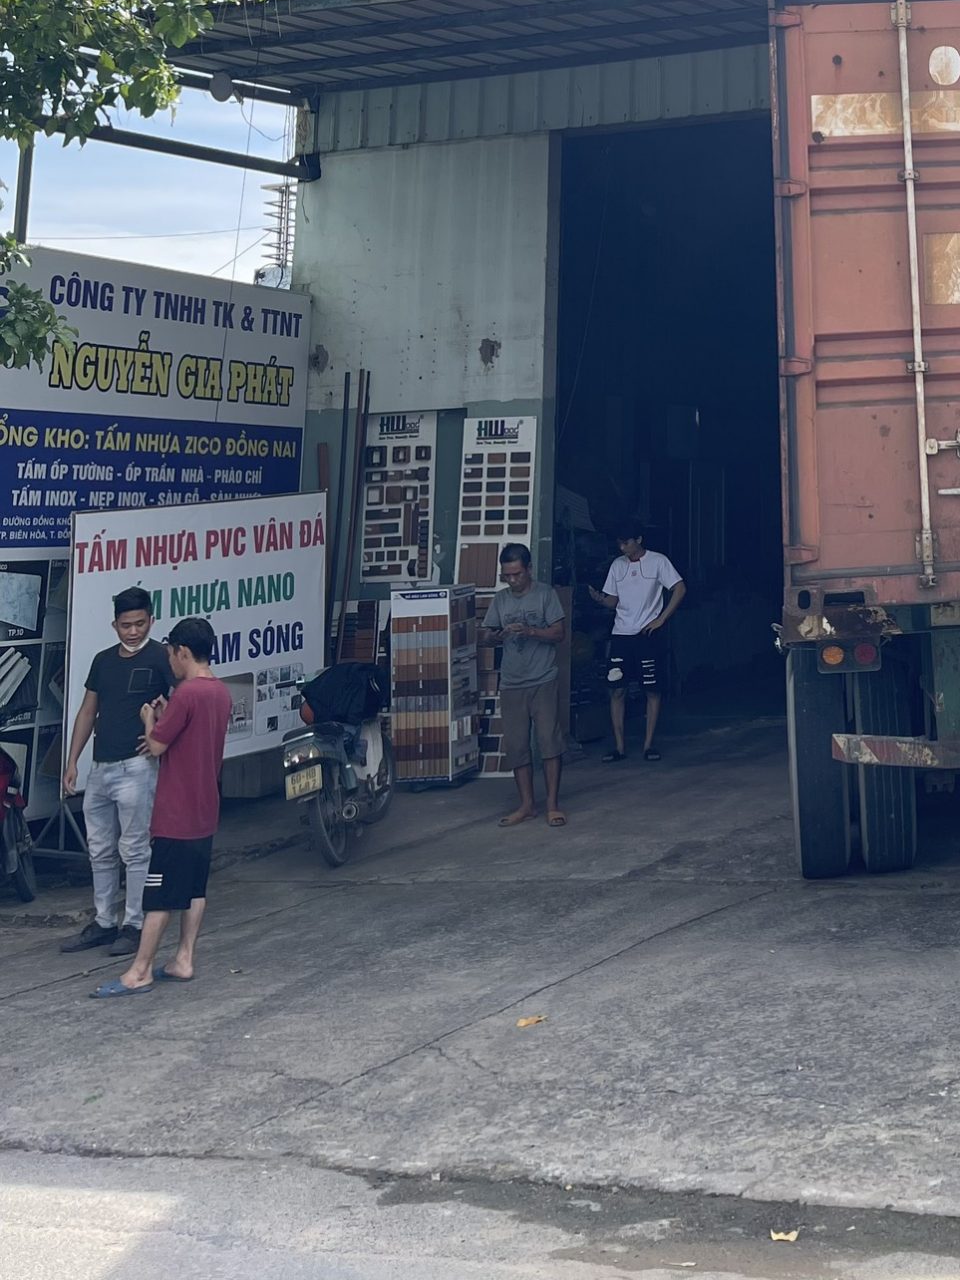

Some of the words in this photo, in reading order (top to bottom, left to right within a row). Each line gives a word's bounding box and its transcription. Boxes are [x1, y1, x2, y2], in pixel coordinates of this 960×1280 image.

[50, 272, 114, 311] CÔNG
[122, 286, 147, 316] TY
[153, 291, 206, 325] TNHH
[212, 301, 235, 329] TK
[241, 306, 254, 332] &
[261, 308, 302, 338] TTNT
[48, 330, 173, 398] NGUYỄN
[176, 354, 223, 401] GIA
[227, 355, 294, 407] PHÁT
[0, 413, 38, 447] ỔNG
[44, 428, 90, 449] KHO:
[95, 423, 131, 451] TẤM
[136, 432, 180, 458] NHỰA
[185, 436, 221, 455] ZICO
[225, 430, 269, 457] ĐỒNG
[273, 440, 296, 458] NAI
[17, 457, 46, 479] TẤM
[50, 458, 69, 480] ỐP
[72, 461, 114, 481] TƯỜNG
[125, 461, 142, 481] ỐP
[145, 462, 175, 482] TRẦN
[181, 465, 204, 483] NHÀ
[12, 484, 42, 506] TẤM
[45, 490, 77, 507] INOX
[89, 491, 115, 510] NẸP
[117, 492, 147, 507] INOX
[9, 529, 28, 540] BIÊN
[75, 529, 127, 574] TẤM
[135, 529, 198, 570] NHỰA
[205, 527, 246, 559] PVC
[253, 517, 293, 554] VÂN
[299, 514, 325, 548] ĐÁ
[170, 579, 231, 619] NHỰA
[238, 572, 295, 608] NANO
[208, 631, 241, 666] AM
[248, 620, 304, 659] SÓNG
